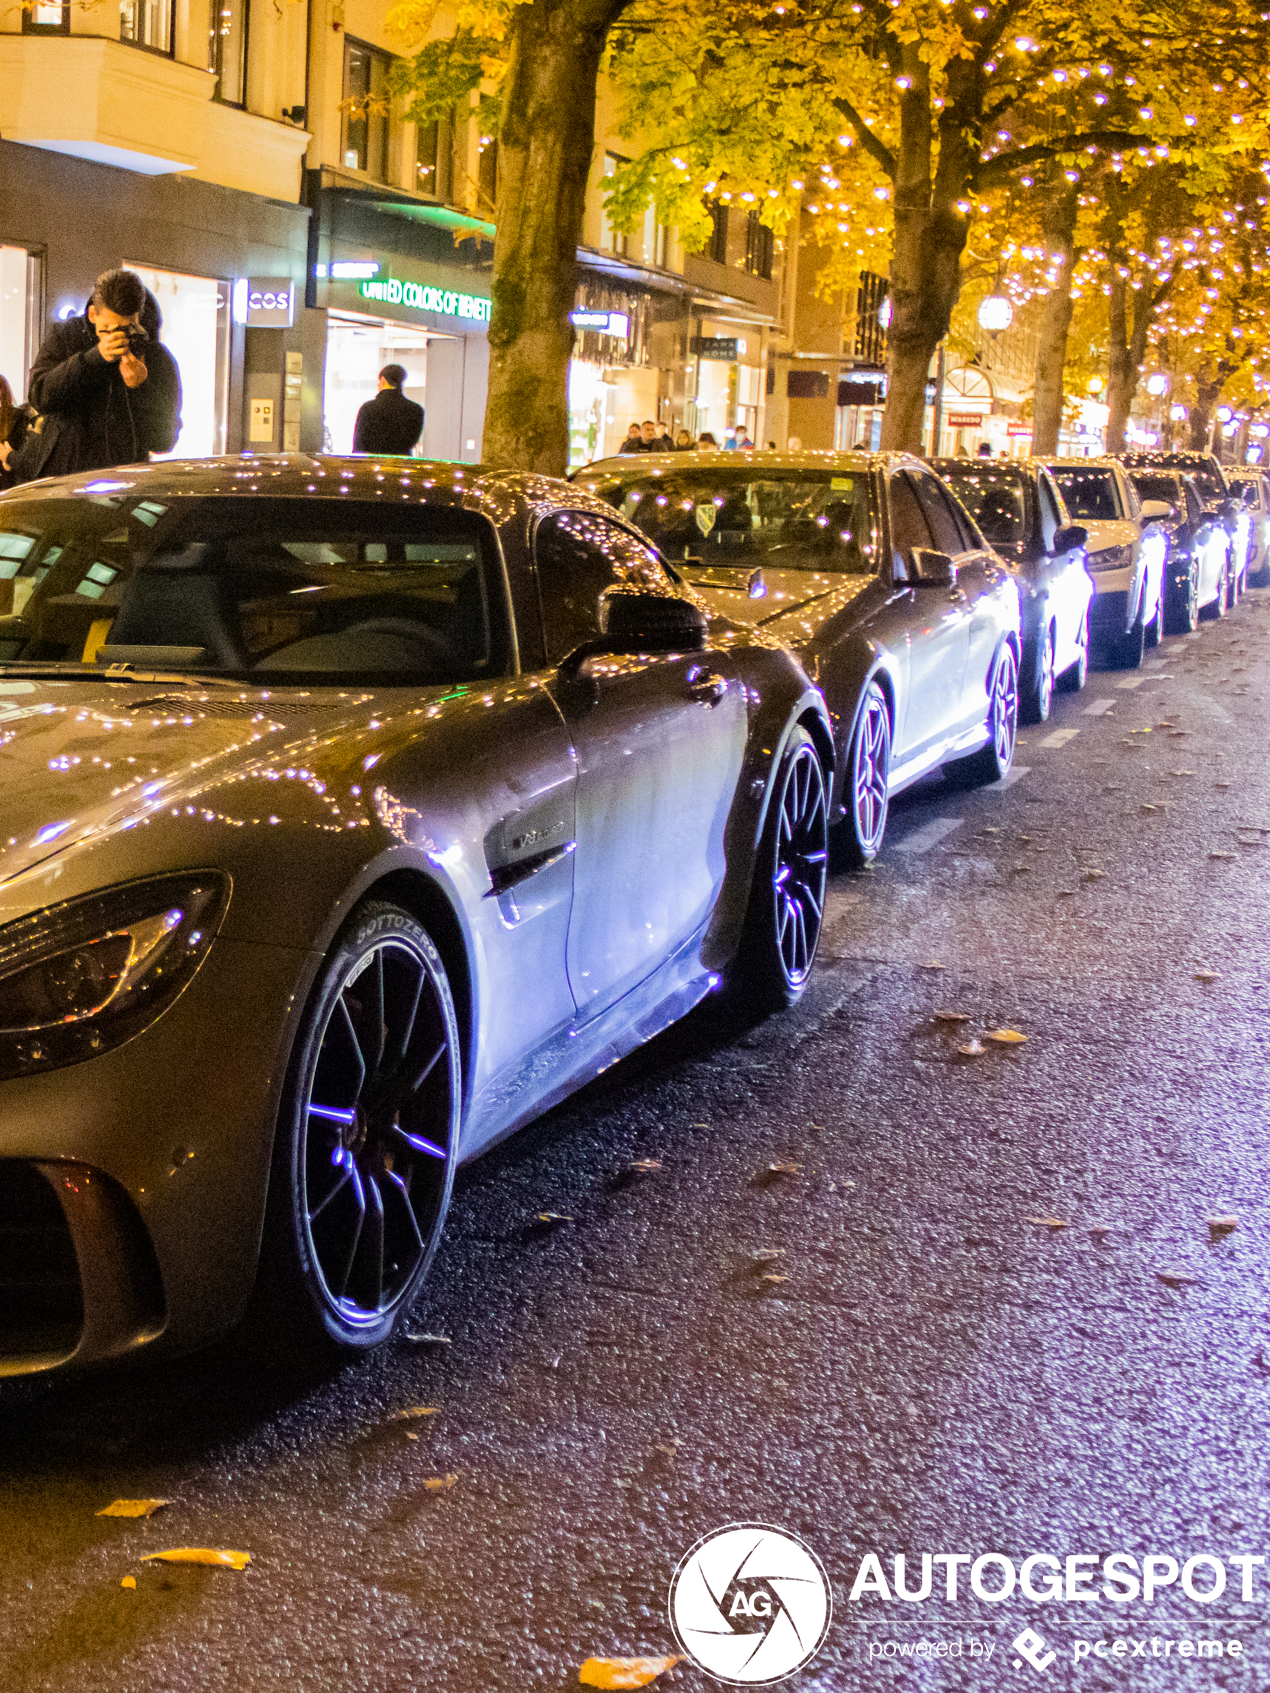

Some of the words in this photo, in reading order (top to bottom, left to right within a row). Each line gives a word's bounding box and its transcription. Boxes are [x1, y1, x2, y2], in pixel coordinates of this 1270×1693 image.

[248, 292, 288, 310] COS
[362, 278, 402, 305] UNITED
[403, 281, 443, 313] COLORS
[444, 290, 459, 315] OF
[458, 294, 492, 322] BENETT
[356, 913, 438, 960] SOTTOZERO
